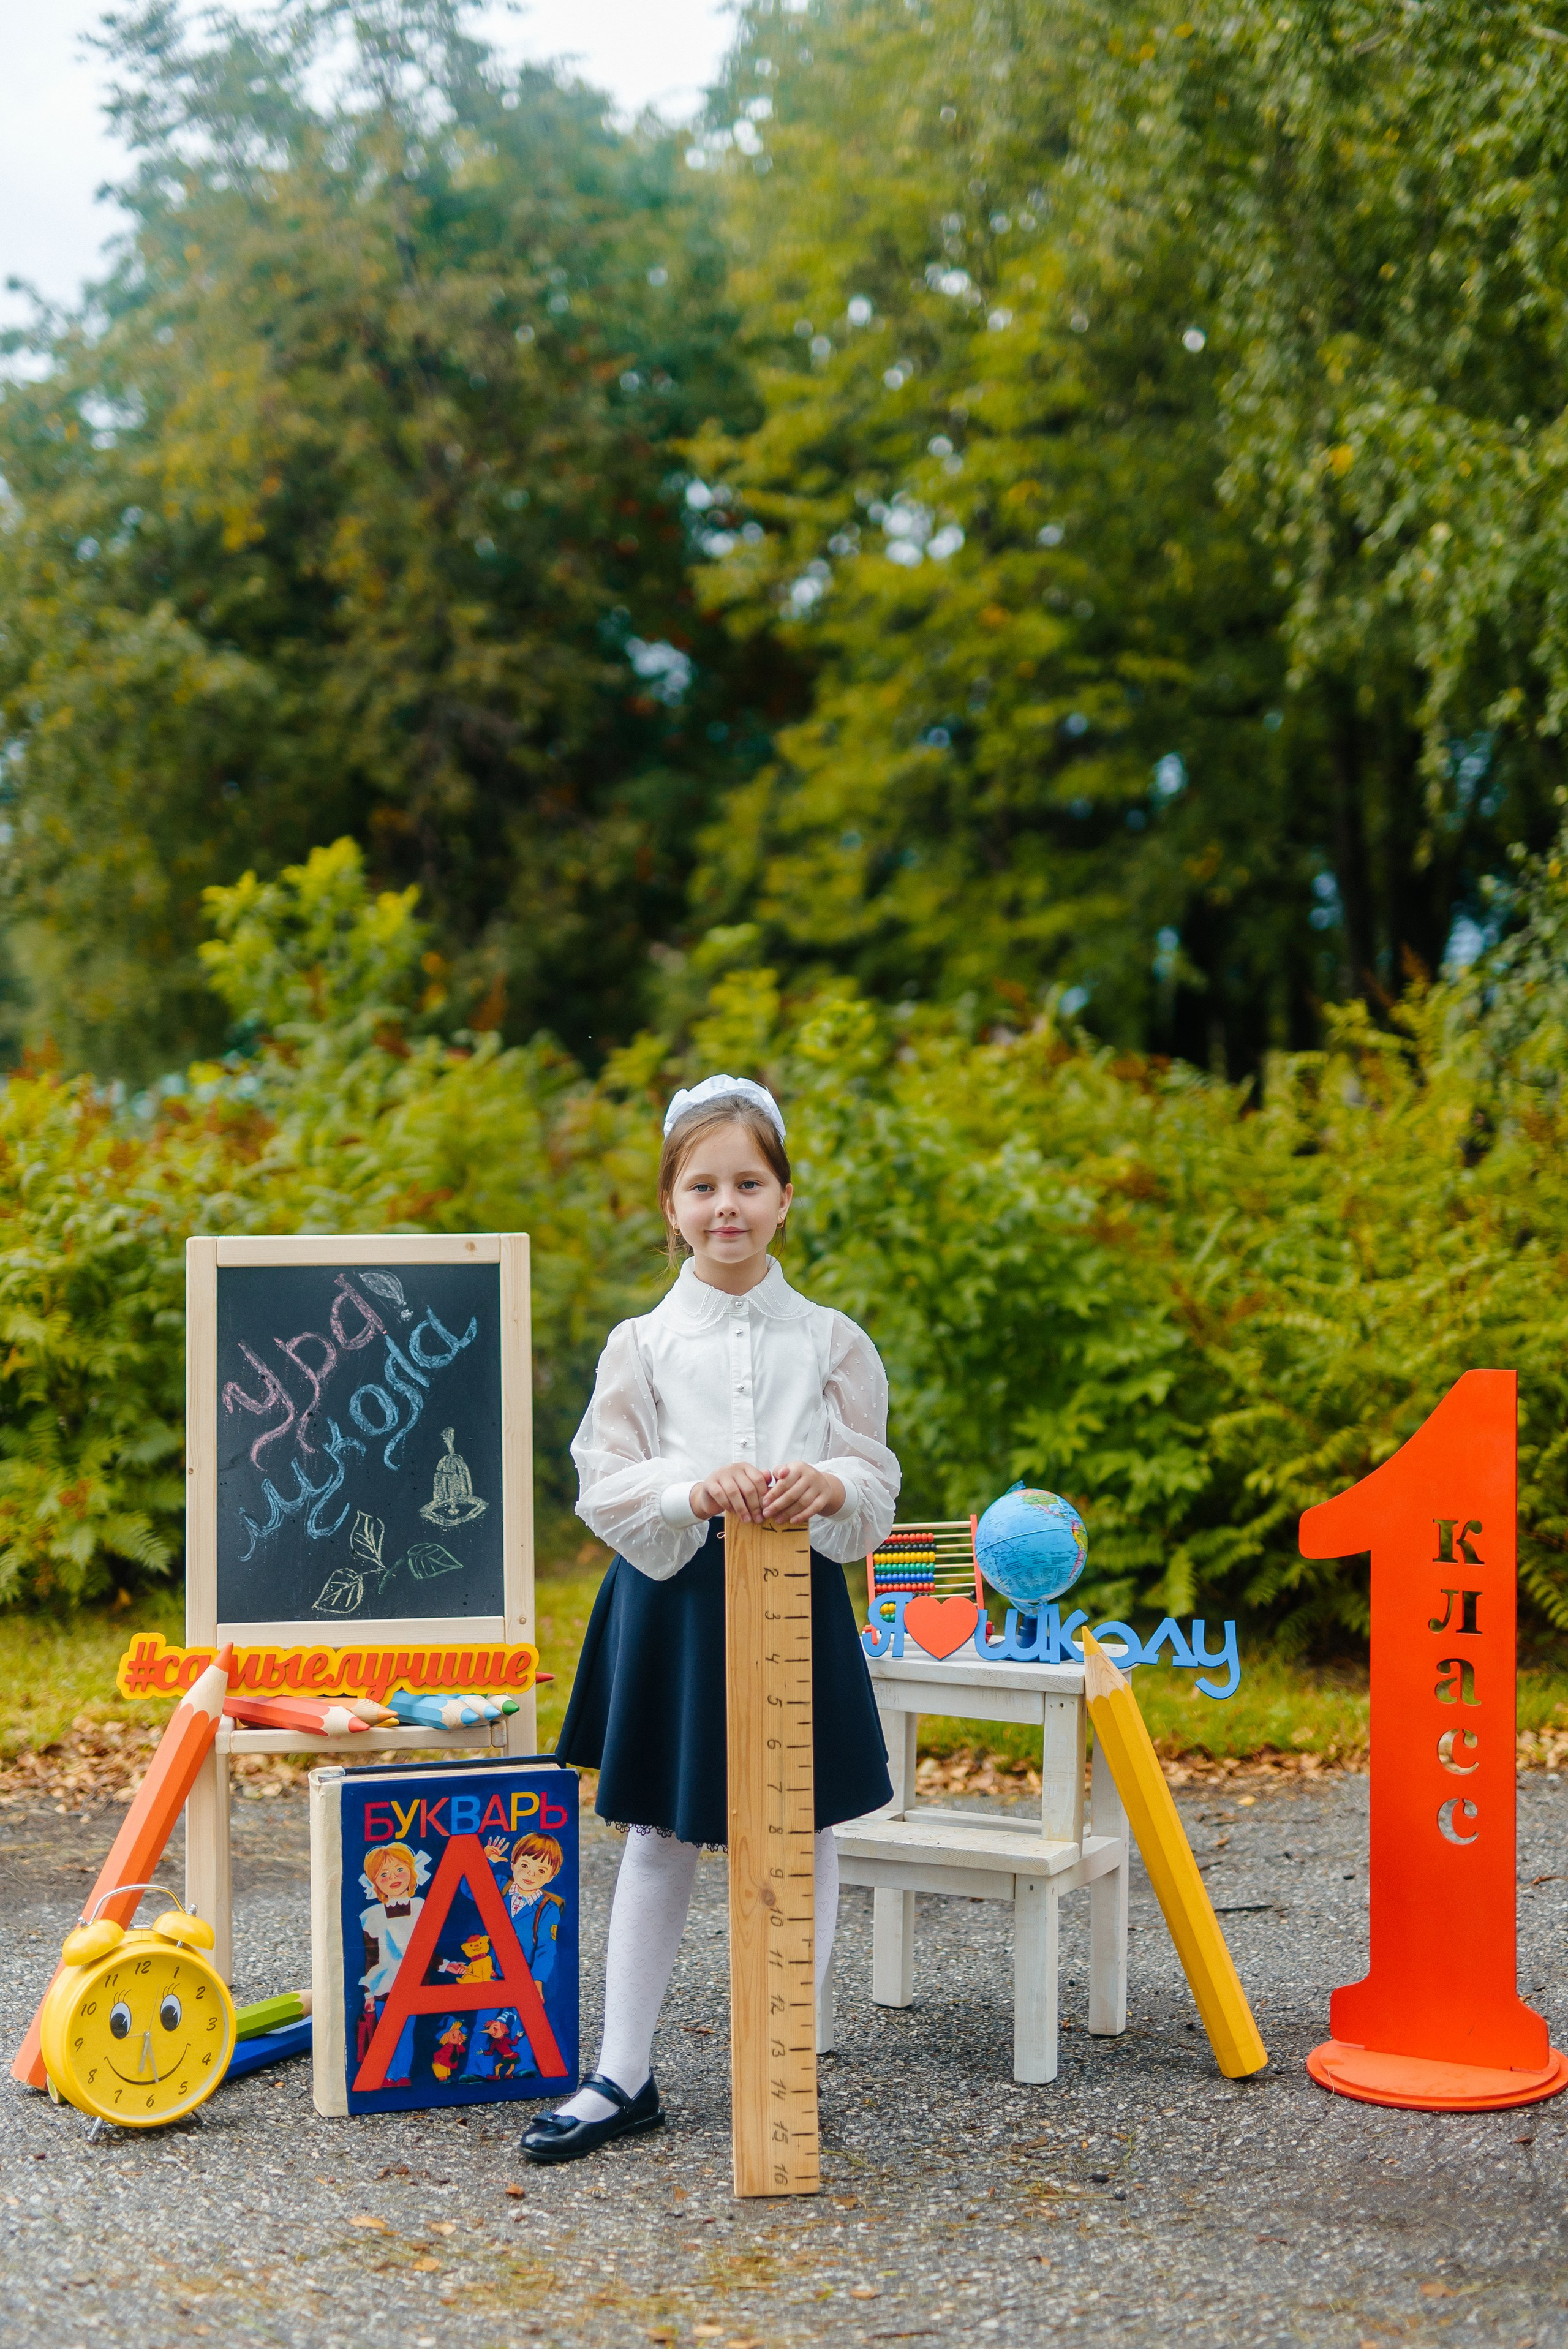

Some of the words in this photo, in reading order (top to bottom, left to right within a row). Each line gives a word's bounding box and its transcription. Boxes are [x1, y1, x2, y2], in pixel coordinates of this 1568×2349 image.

[761, 1522, 778, 1533] 1
[763, 1567, 779, 1582] 2
[764, 1610, 781, 1621] 3
[862, 1592, 913, 1657] Я
[765, 1653, 781, 1664] 4
[767, 1695, 782, 1708] 5
[767, 1738, 782, 1750] 6
[767, 1781, 782, 1794] 7
[364, 1792, 568, 1842] БУКВАРЬ
[769, 1825, 783, 1835] 8
[769, 1868, 783, 1879] 9
[770, 1906, 784, 1928] 10
[769, 1949, 783, 1969] 11
[135, 1961, 151, 1975] 12
[173, 1966, 179, 1979] 1
[104, 1973, 118, 1988] 11
[195, 1986, 205, 2000] 2
[81, 2002, 97, 2016] 10
[771, 1994, 786, 2015] 12
[206, 2017, 217, 2031] 3
[74, 2037, 83, 2052] 9
[771, 2038, 786, 2058] 13
[202, 2052, 211, 2066] 4
[88, 2068, 97, 2084] 8
[178, 2081, 188, 2095] 5
[771, 2079, 786, 2101] 14
[114, 2089, 123, 2104] 7
[146, 2094, 154, 2108] 6
[772, 2121, 788, 2144] 15
[774, 2163, 788, 2186] 16
